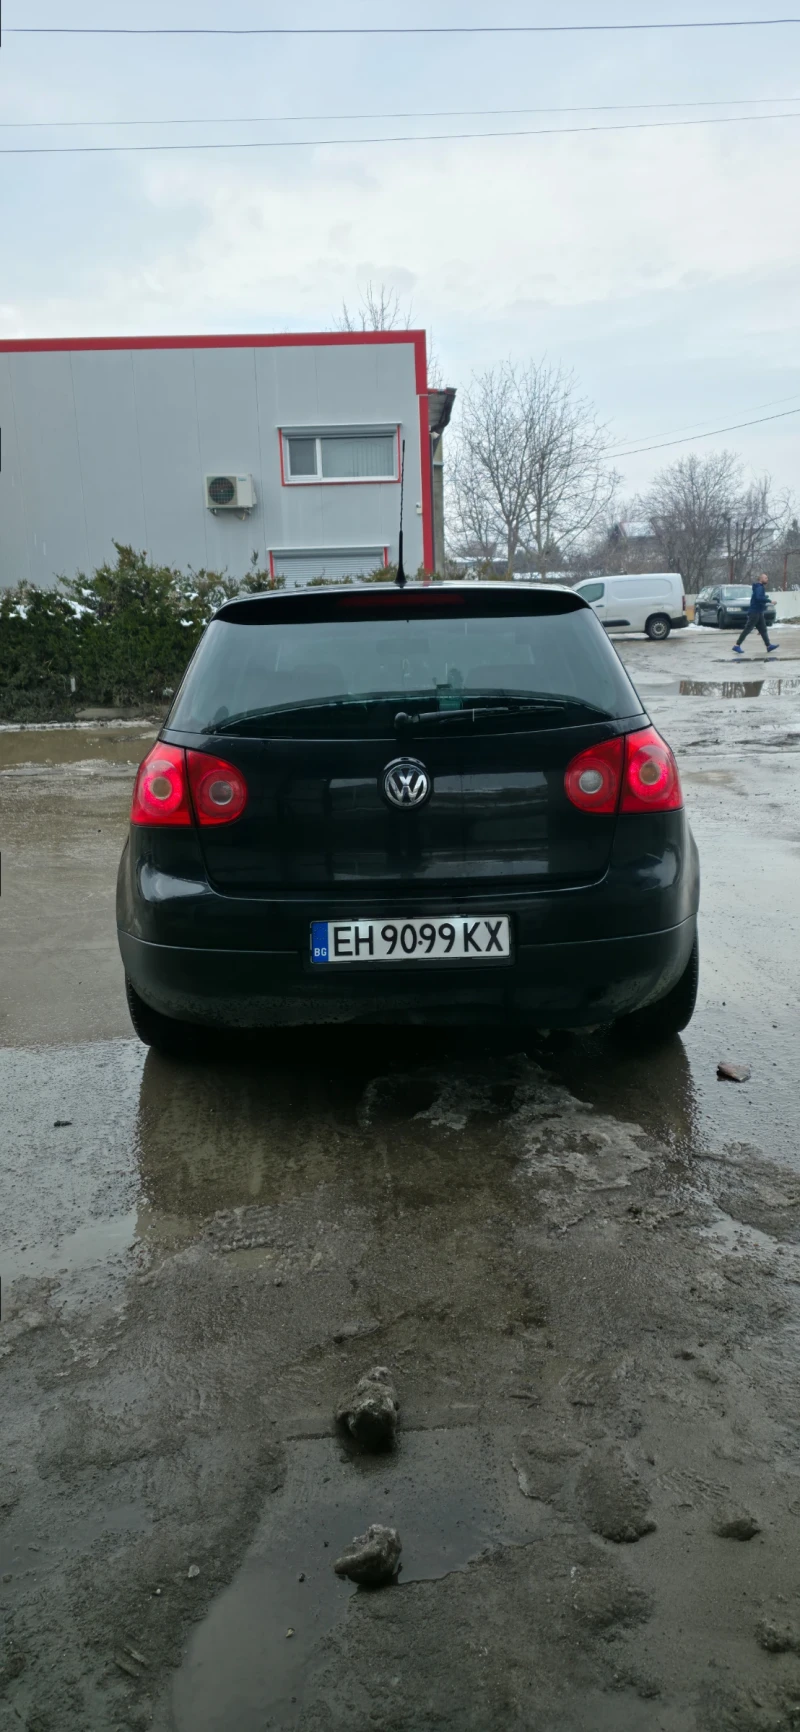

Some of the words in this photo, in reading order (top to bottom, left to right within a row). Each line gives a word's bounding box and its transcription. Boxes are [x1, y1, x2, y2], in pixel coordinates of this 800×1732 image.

[385, 764, 427, 806] VW
[314, 948, 327, 957] BG
[333, 925, 374, 956] EH
[381, 923, 455, 955] 9099
[463, 921, 504, 953] KX
